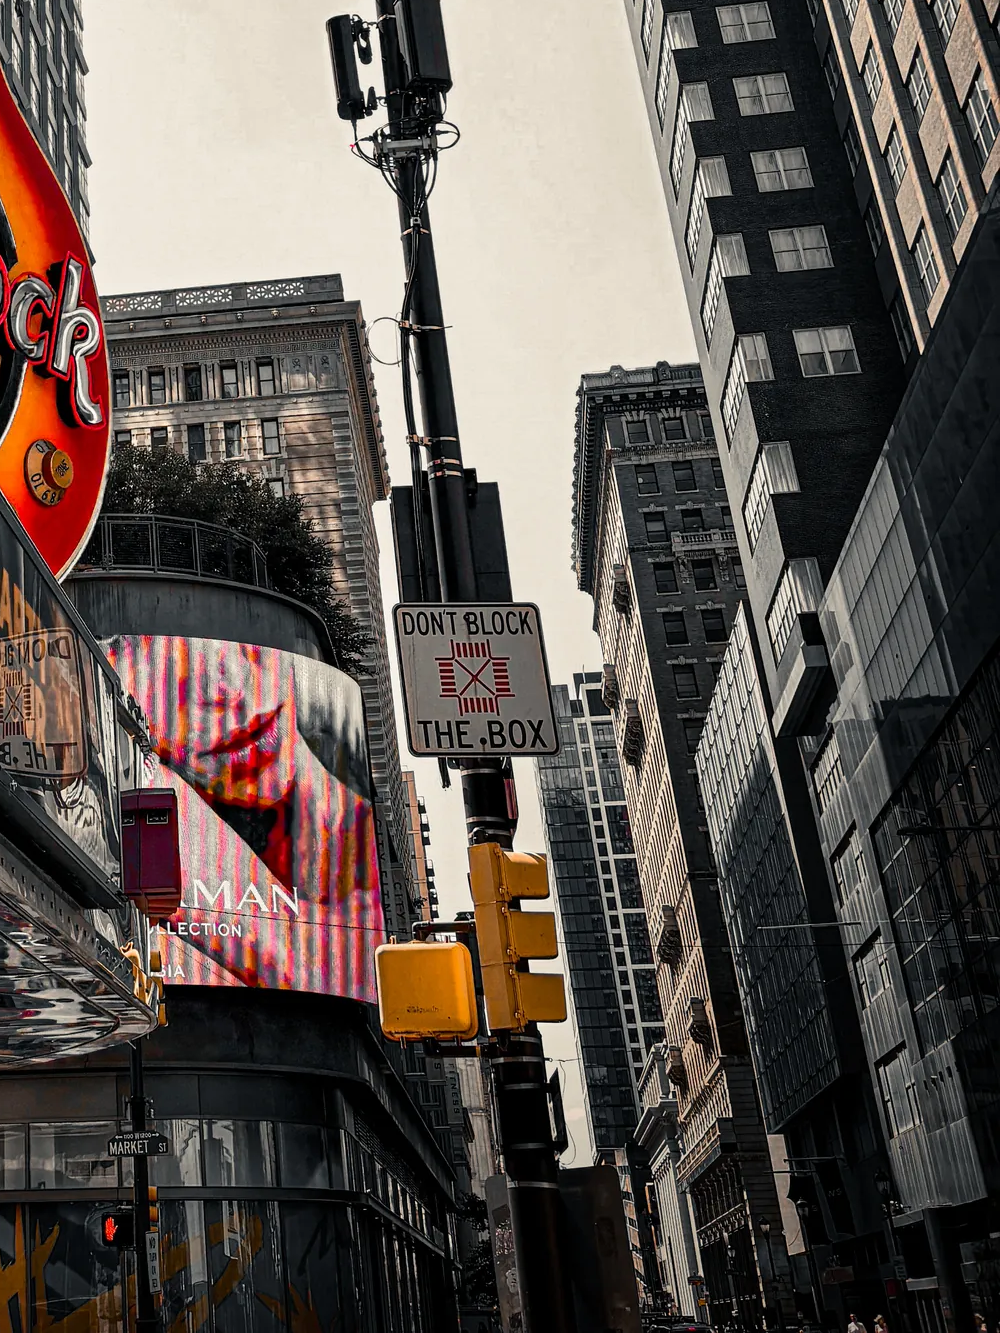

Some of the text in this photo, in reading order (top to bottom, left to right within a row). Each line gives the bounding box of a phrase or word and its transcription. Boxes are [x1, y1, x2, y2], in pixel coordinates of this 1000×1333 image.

[401, 609, 534, 636] DON'T BLOCK
[417, 719, 549, 749] THE BOX
[180, 879, 300, 916] MAN
[109, 1140, 167, 1156] MARKET ST
